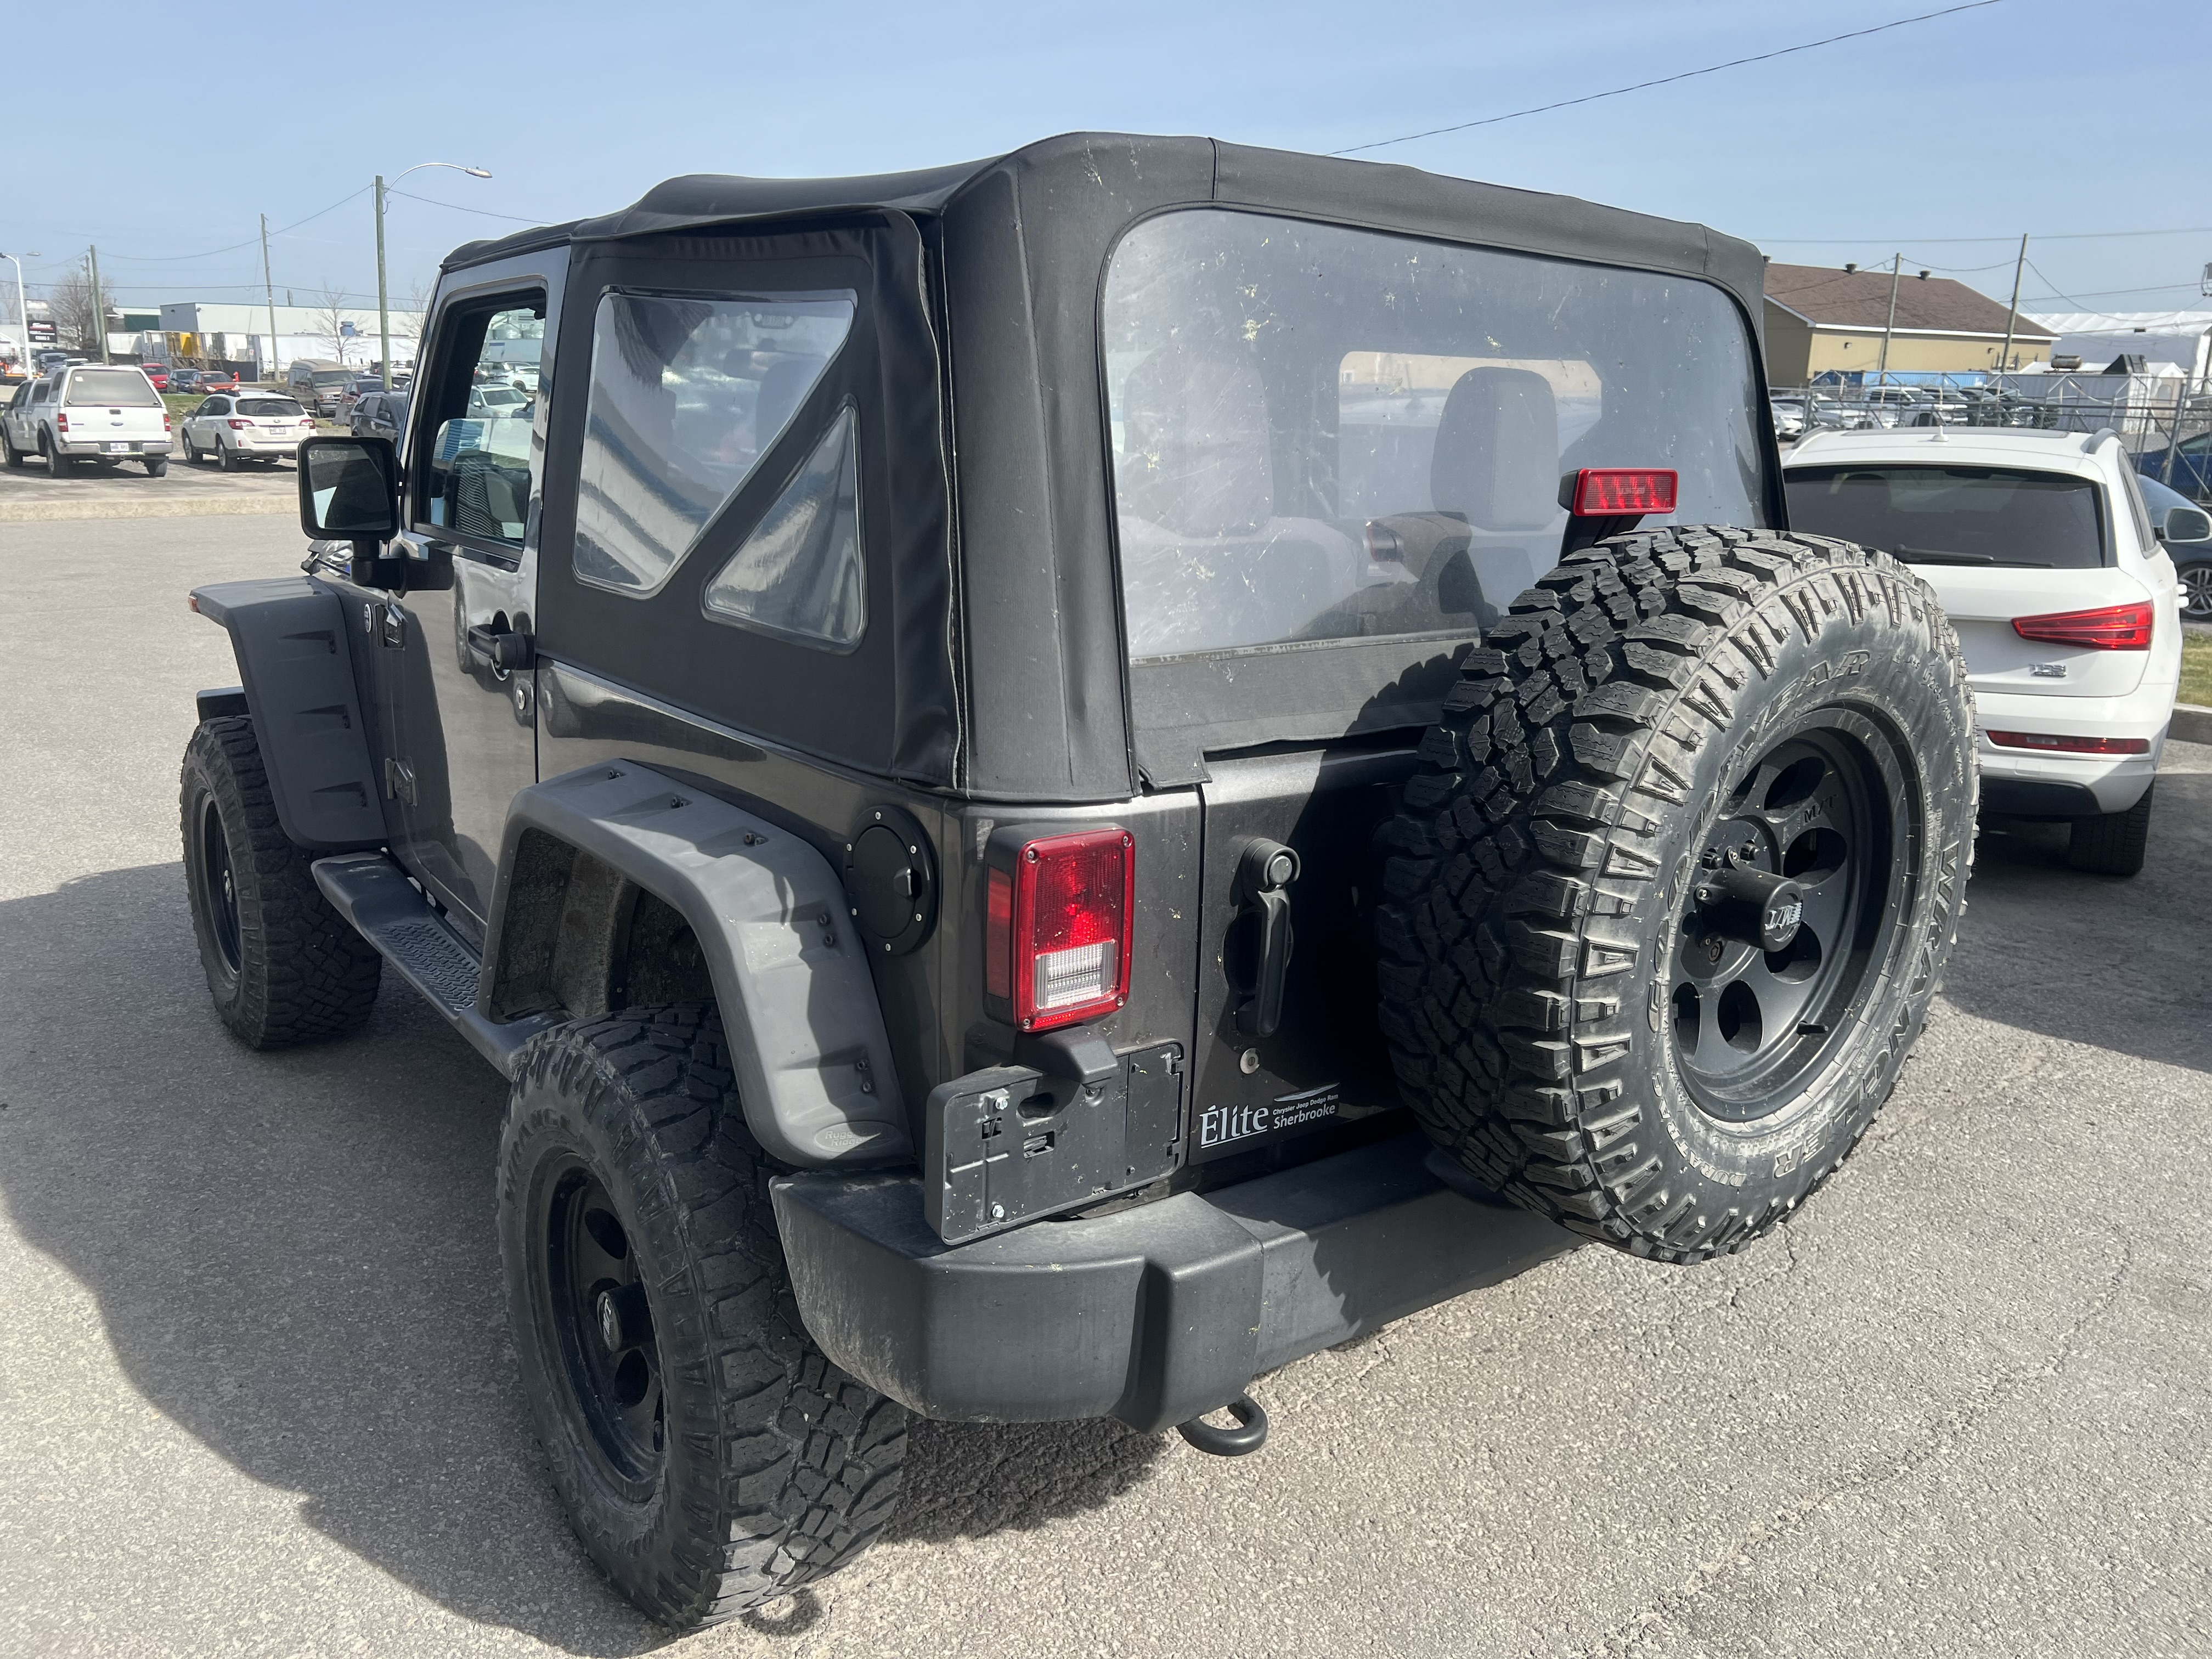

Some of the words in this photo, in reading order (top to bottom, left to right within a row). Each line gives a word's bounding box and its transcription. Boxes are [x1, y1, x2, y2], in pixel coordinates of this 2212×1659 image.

[1273, 1105, 1295, 1115] Chrysler
[1310, 1097, 1327, 1105] Dodge
[1273, 1103, 1335, 1129] Sherbrooke
[1199, 1104, 1269, 1146] Élite
[1652, 1074, 1747, 1187] DURATRAC
